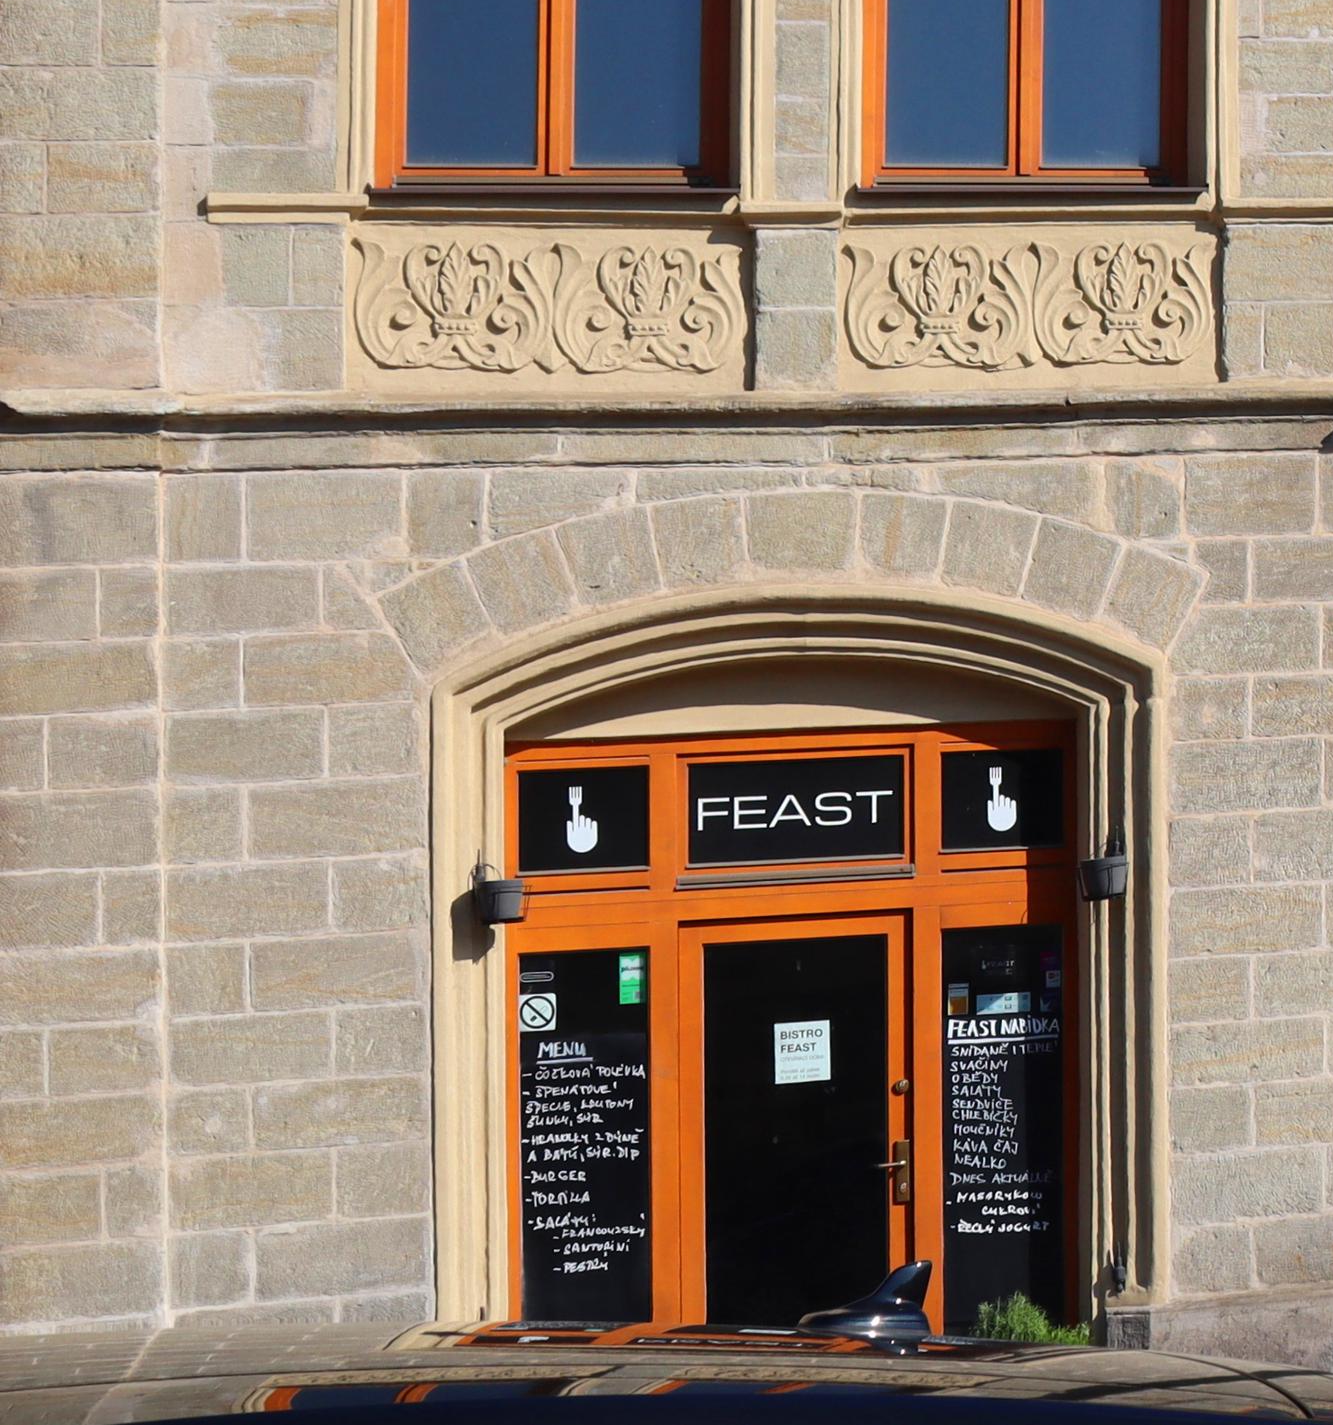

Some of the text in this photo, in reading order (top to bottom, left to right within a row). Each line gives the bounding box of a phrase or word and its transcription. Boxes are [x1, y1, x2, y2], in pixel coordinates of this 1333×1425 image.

[697, 790, 894, 832] FEAST
[780, 1028, 823, 1040] BISTRO
[947, 1018, 998, 1039] FEAST
[537, 1041, 587, 1058] MENU
[780, 1042, 816, 1054] FEAST
[954, 1153, 1007, 1169] NEALKO
[949, 1171, 986, 1186] DNES
